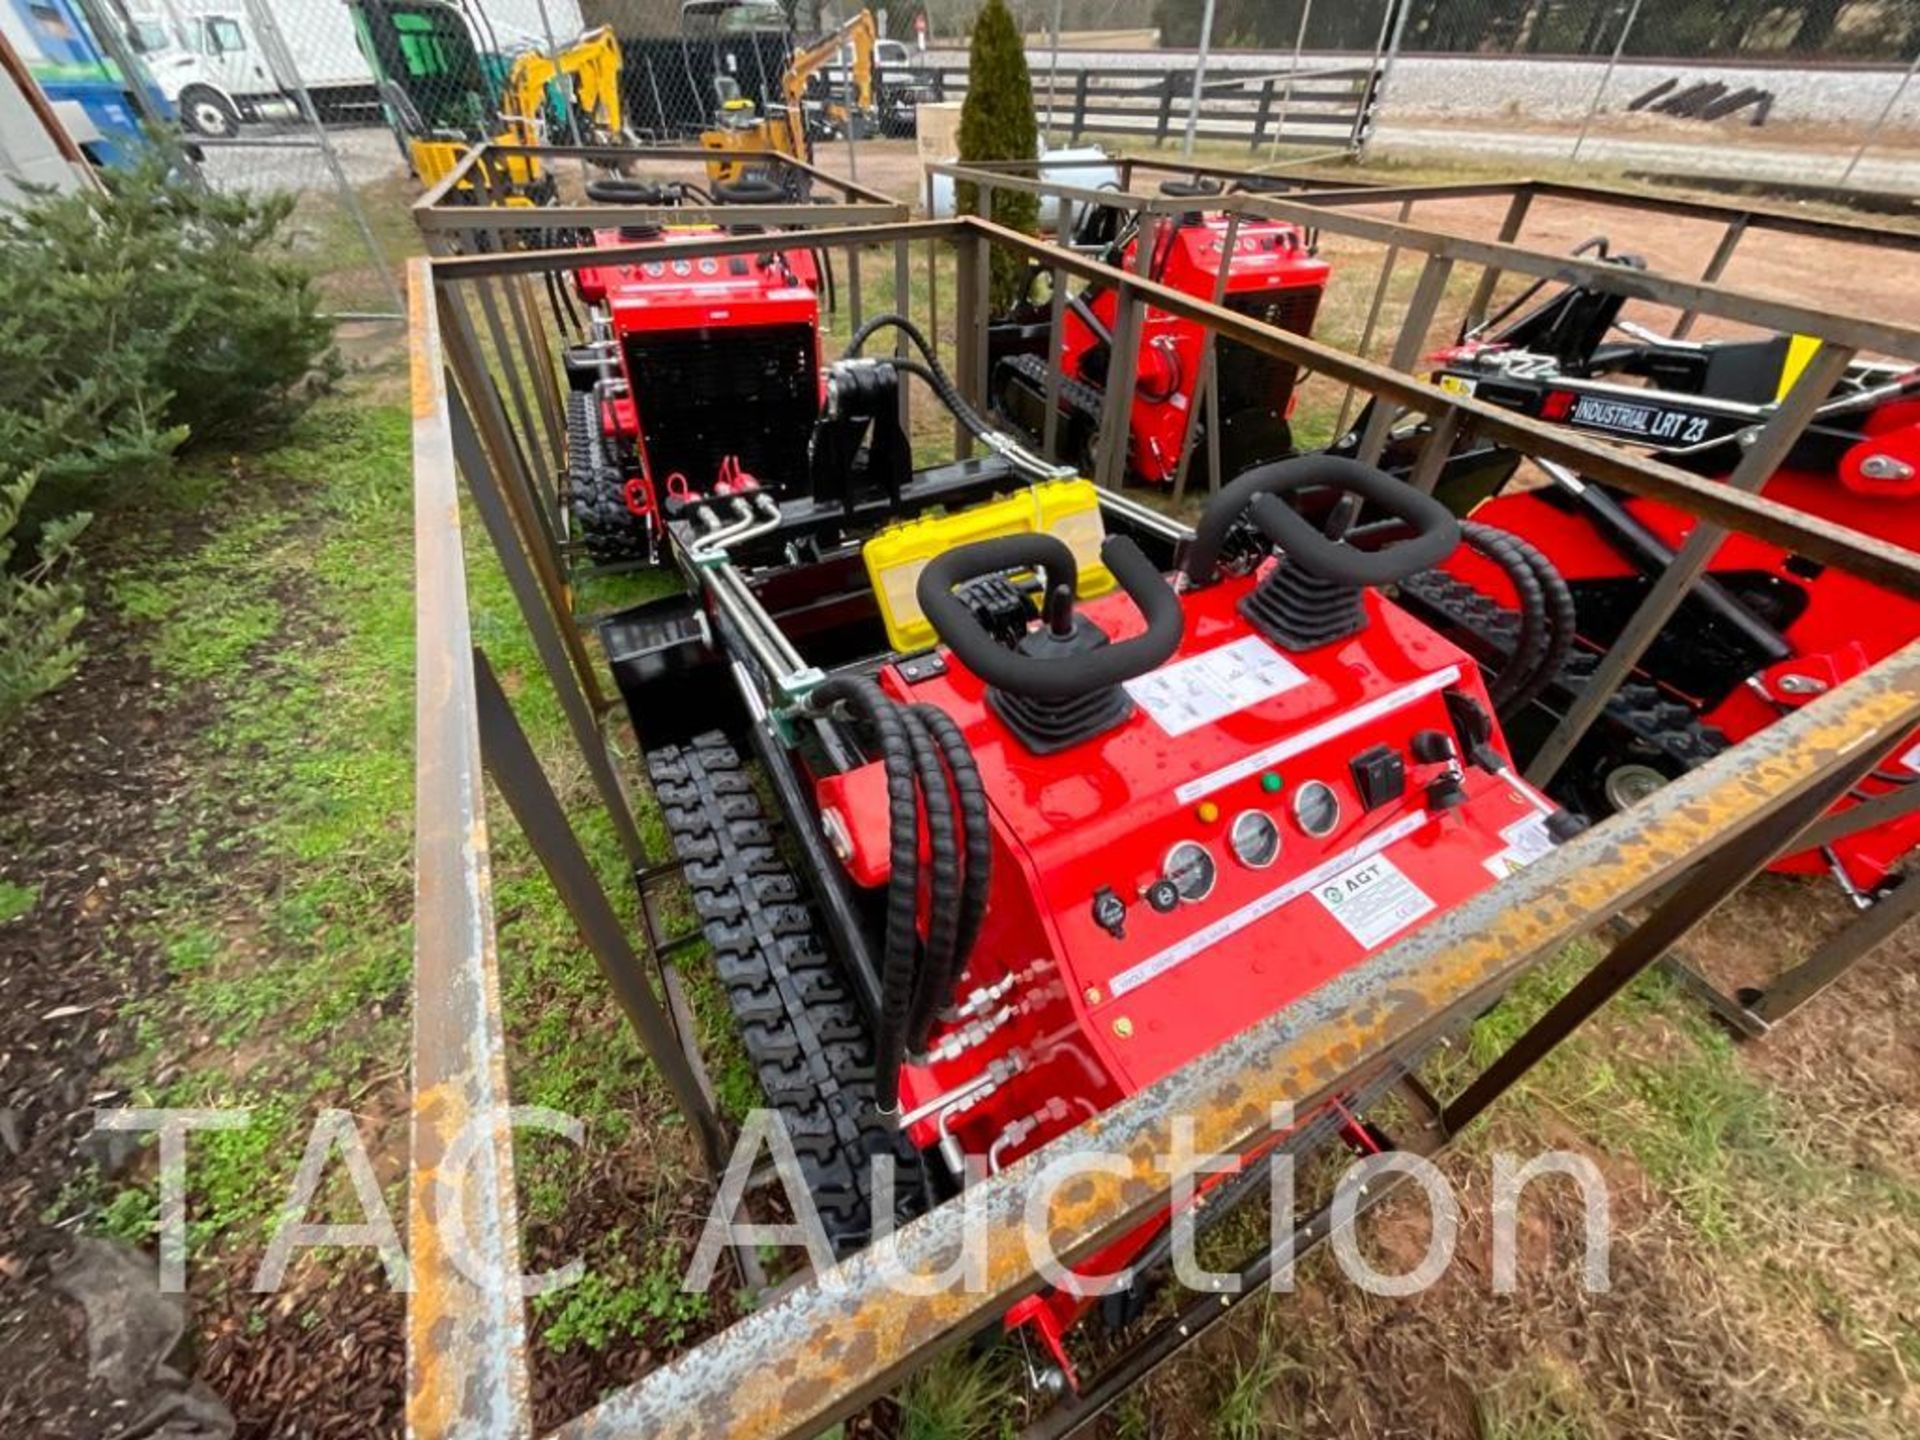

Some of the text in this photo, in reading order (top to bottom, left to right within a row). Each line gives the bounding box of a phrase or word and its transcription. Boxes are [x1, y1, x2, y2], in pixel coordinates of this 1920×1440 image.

[1574, 401, 1708, 442] INDUSTRIAL LRT 23
[1345, 863, 1382, 893] AGT
